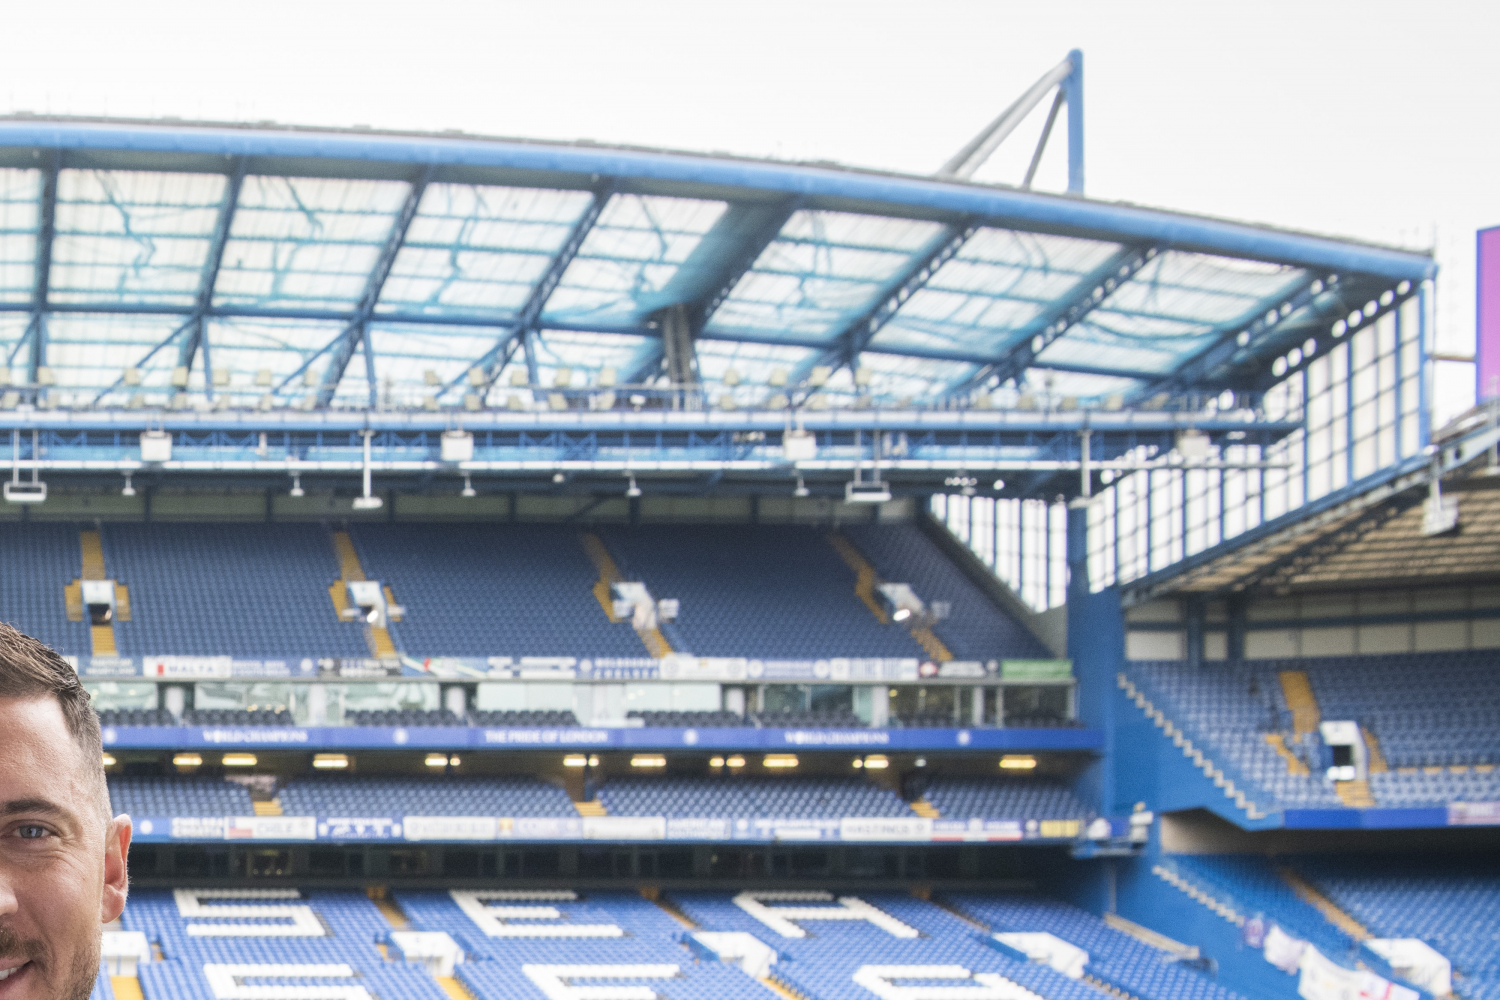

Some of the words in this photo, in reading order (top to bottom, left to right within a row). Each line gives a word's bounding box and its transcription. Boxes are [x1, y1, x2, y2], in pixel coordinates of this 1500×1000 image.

[485, 730, 506, 743] THE
[507, 730, 541, 743] PRIDE
[542, 730, 557, 743] OF
[559, 730, 608, 743] LONDON
